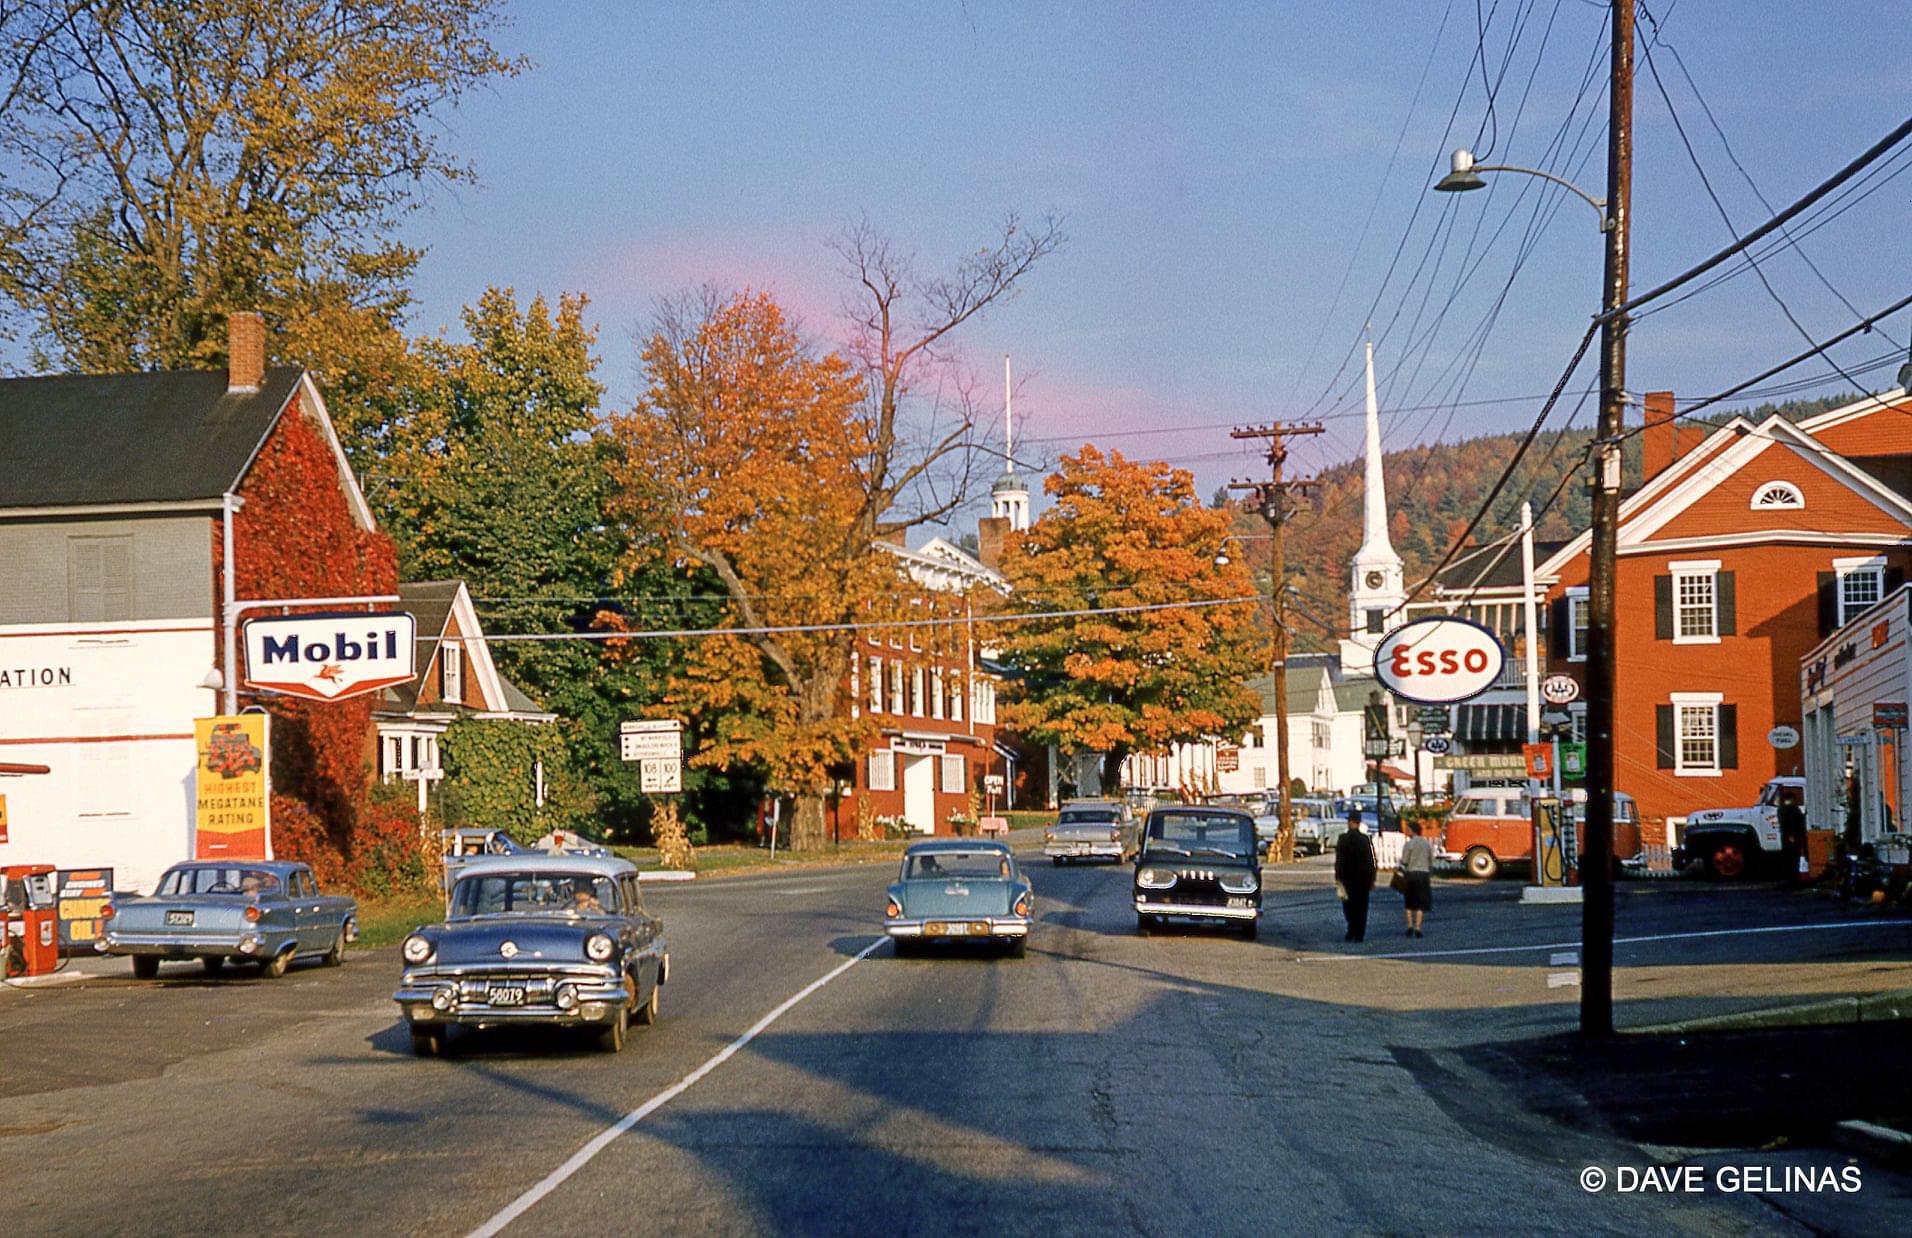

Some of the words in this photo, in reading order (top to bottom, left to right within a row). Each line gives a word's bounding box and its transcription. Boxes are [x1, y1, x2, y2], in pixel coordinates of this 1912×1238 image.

[262, 630, 397, 665] Mobil
[0, 667, 72, 687] ATION
[1488, 754, 1526, 768] MOUN
[644, 762, 657, 774] 108
[663, 762, 677, 774] 100
[204, 782, 257, 794] HIGHEST
[197, 797, 264, 810] MEGATANE
[208, 813, 254, 825] RATING
